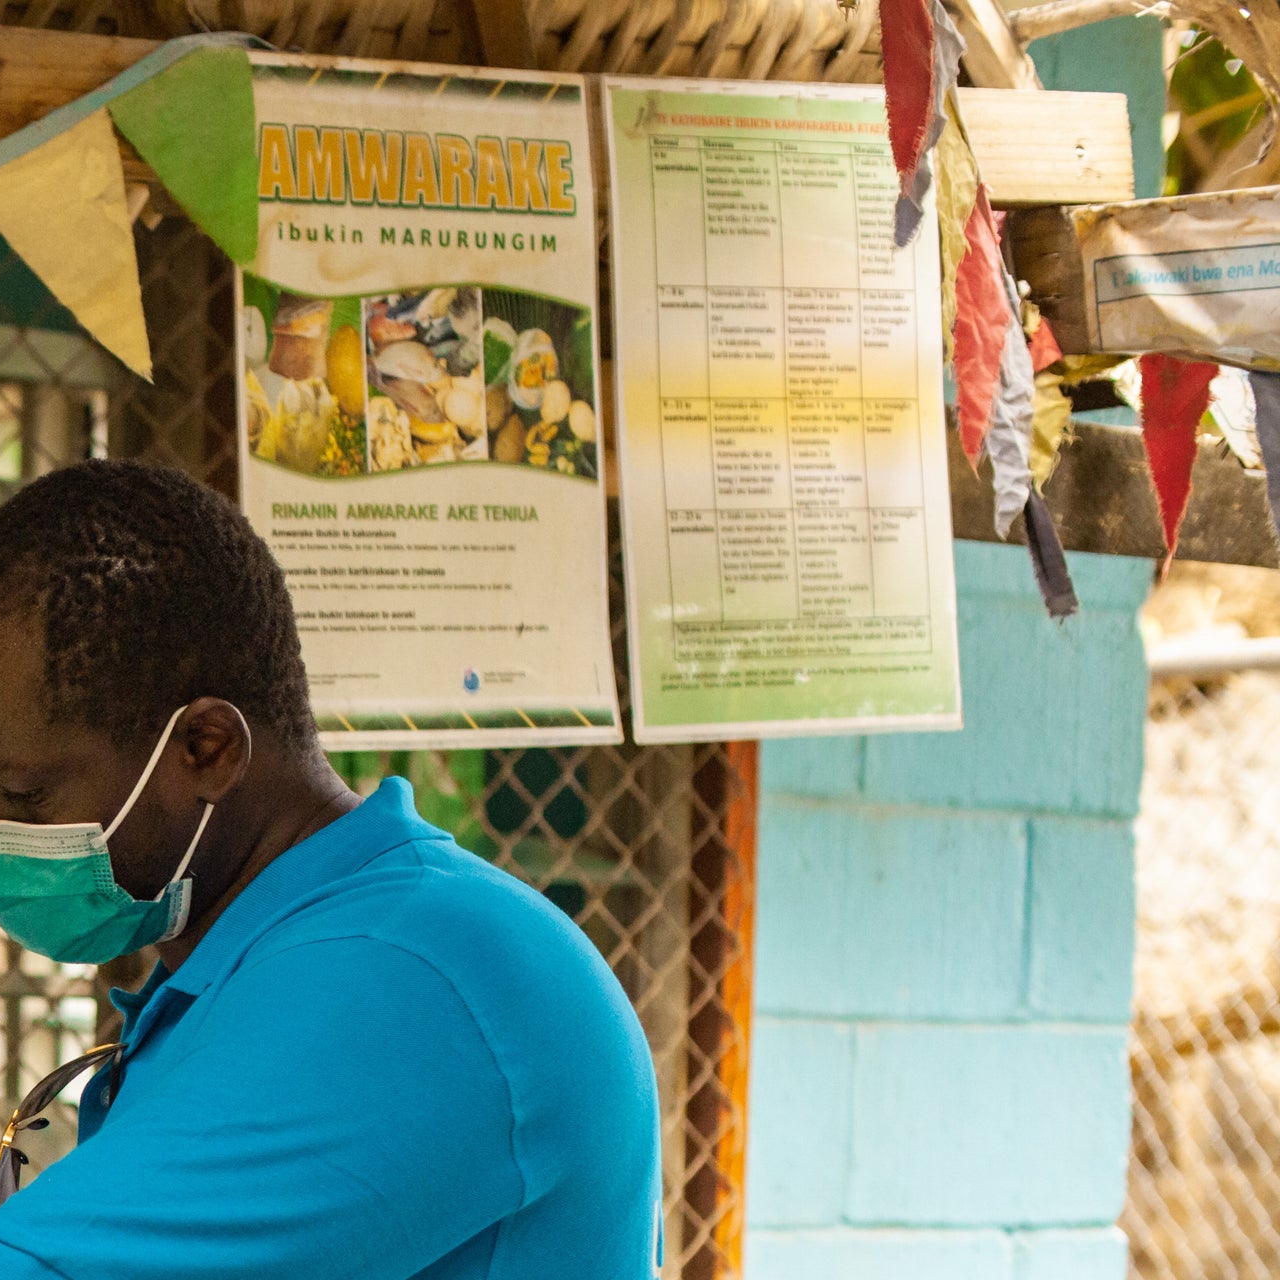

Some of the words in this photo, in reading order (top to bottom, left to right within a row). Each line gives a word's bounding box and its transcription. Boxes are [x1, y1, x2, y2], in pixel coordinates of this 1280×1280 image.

[257, 122, 576, 217] AMWARAKE
[278, 222, 363, 243] ibukin
[381, 227, 557, 252] MARURUNGIM
[1193, 264, 1222, 282] bwa
[1226, 263, 1254, 279] ena
[272, 503, 337, 520] RINANIN
[346, 503, 439, 521] AMWARAKE
[447, 504, 478, 522] AKE
